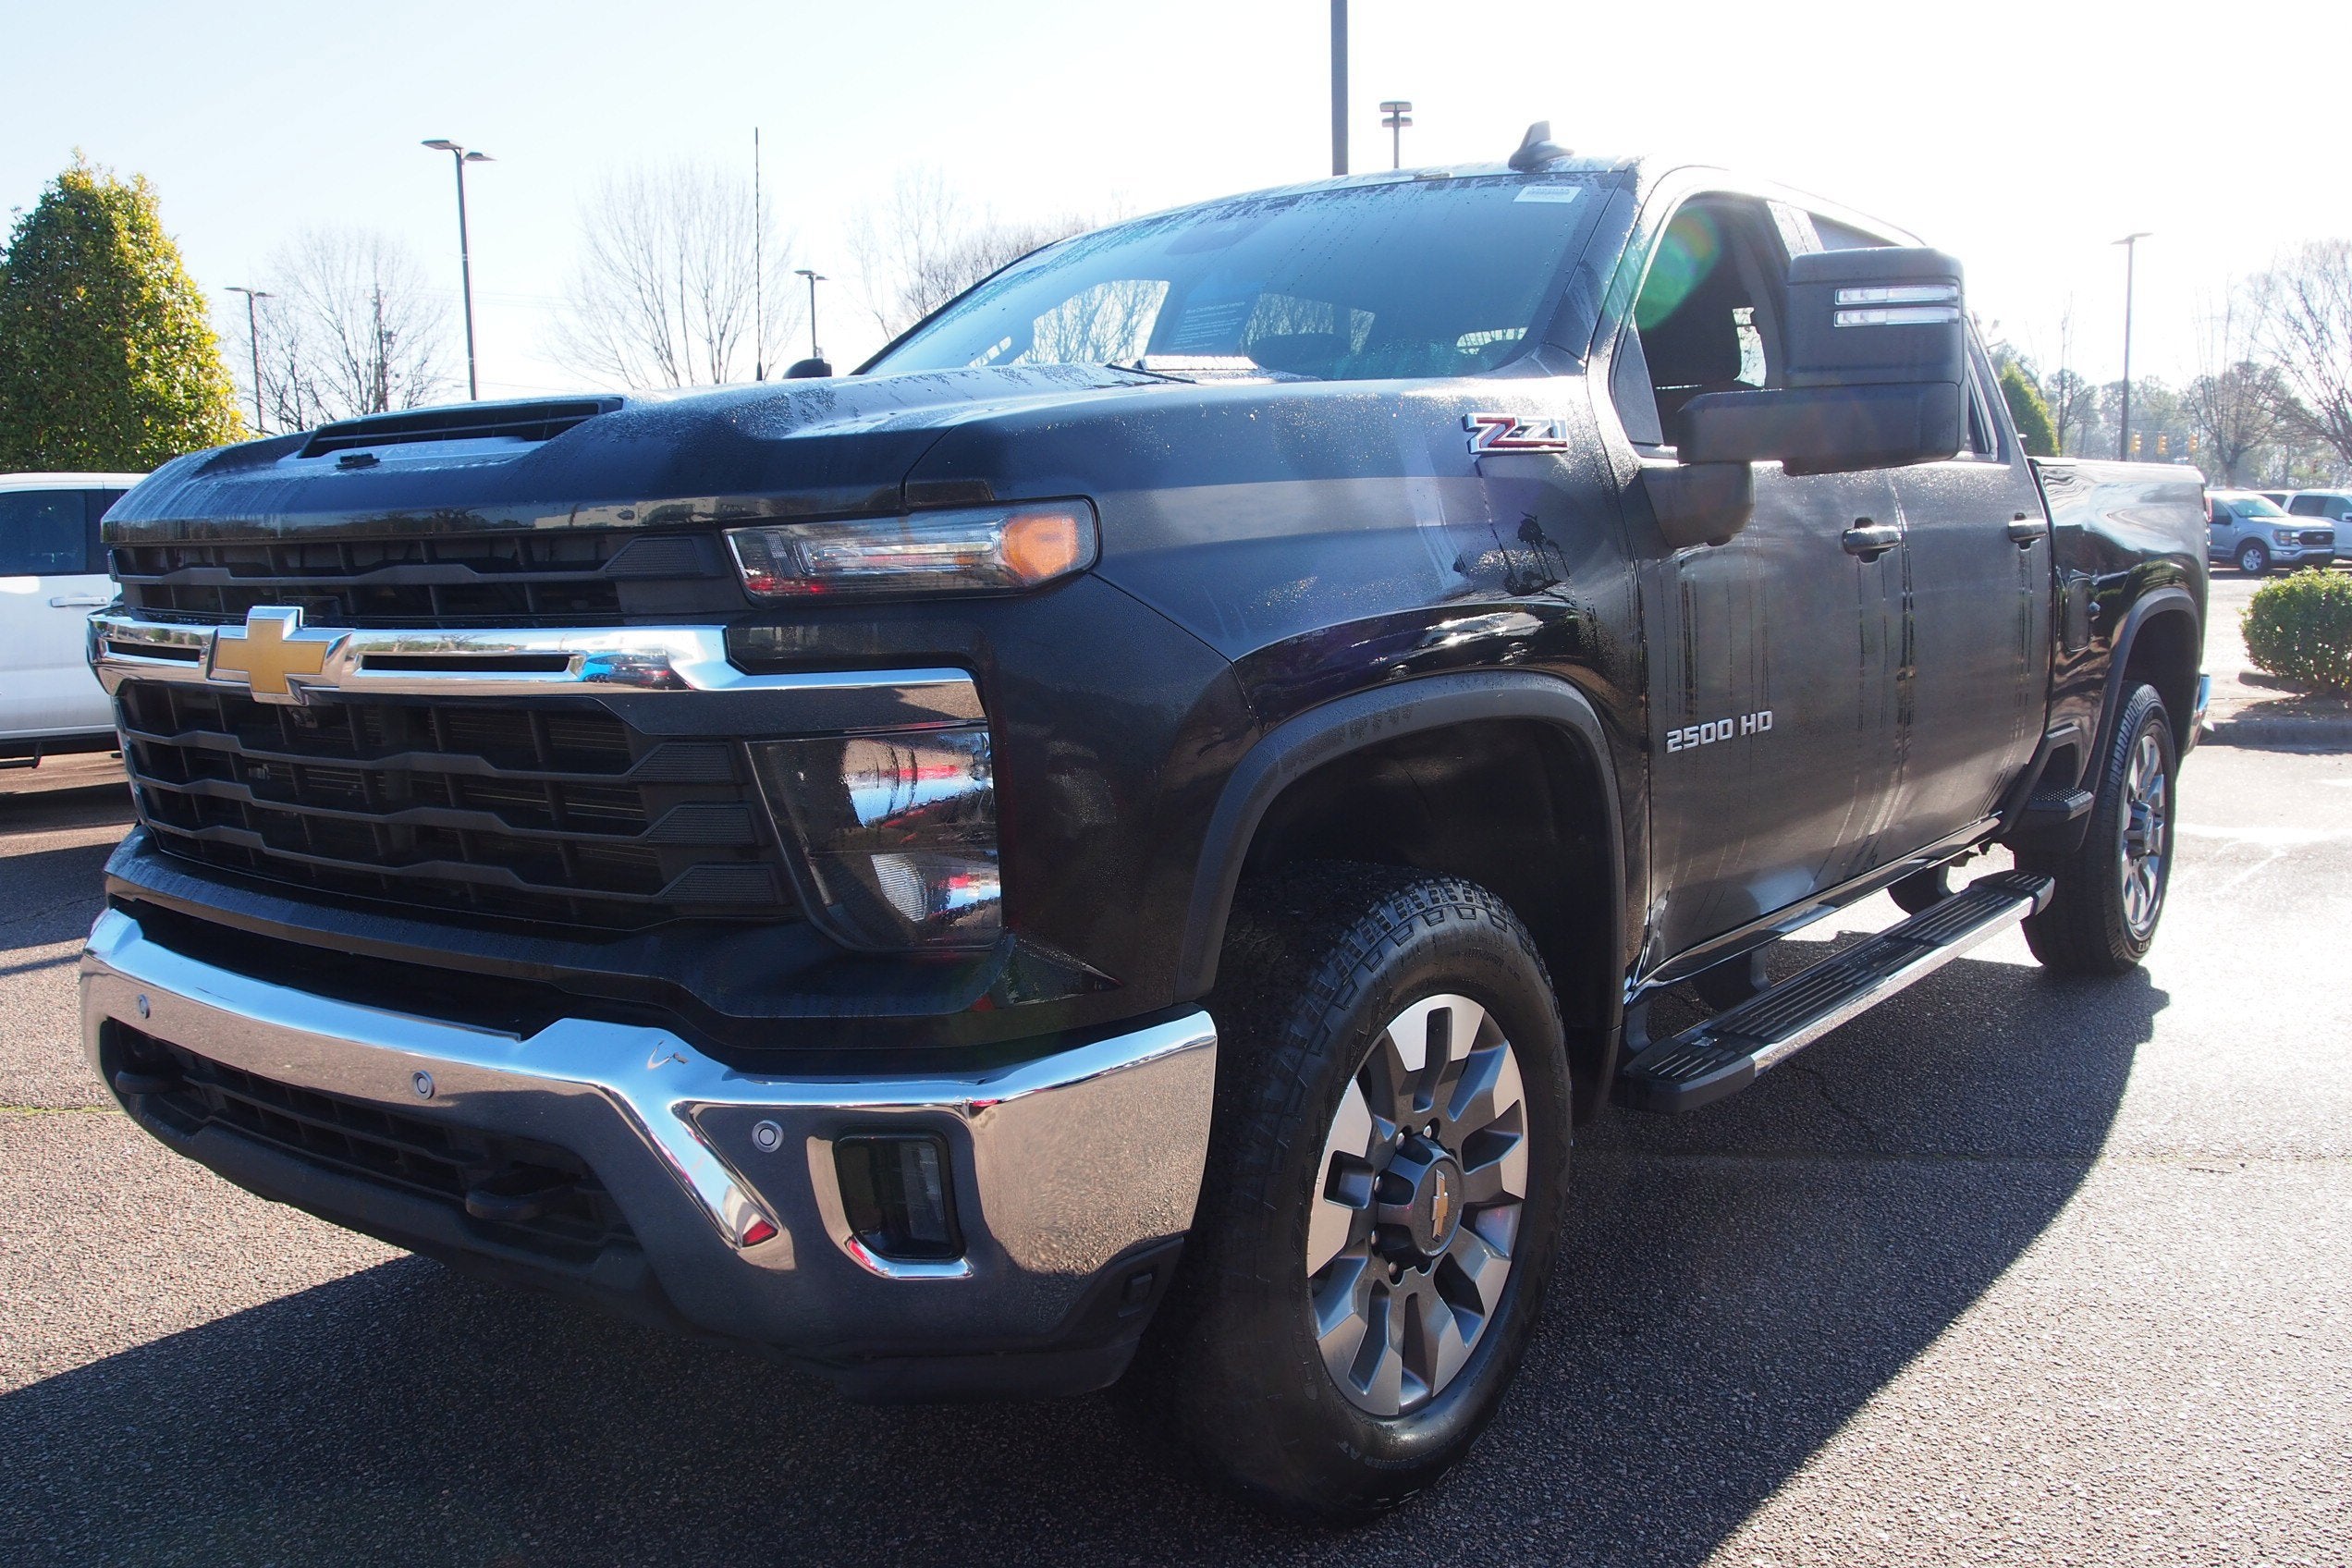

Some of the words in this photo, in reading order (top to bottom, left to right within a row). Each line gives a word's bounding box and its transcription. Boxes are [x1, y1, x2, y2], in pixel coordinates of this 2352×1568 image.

[1461, 412, 1569, 455] Z71
[1666, 717, 1733, 753] 2500
[1739, 709, 1773, 736] HD
